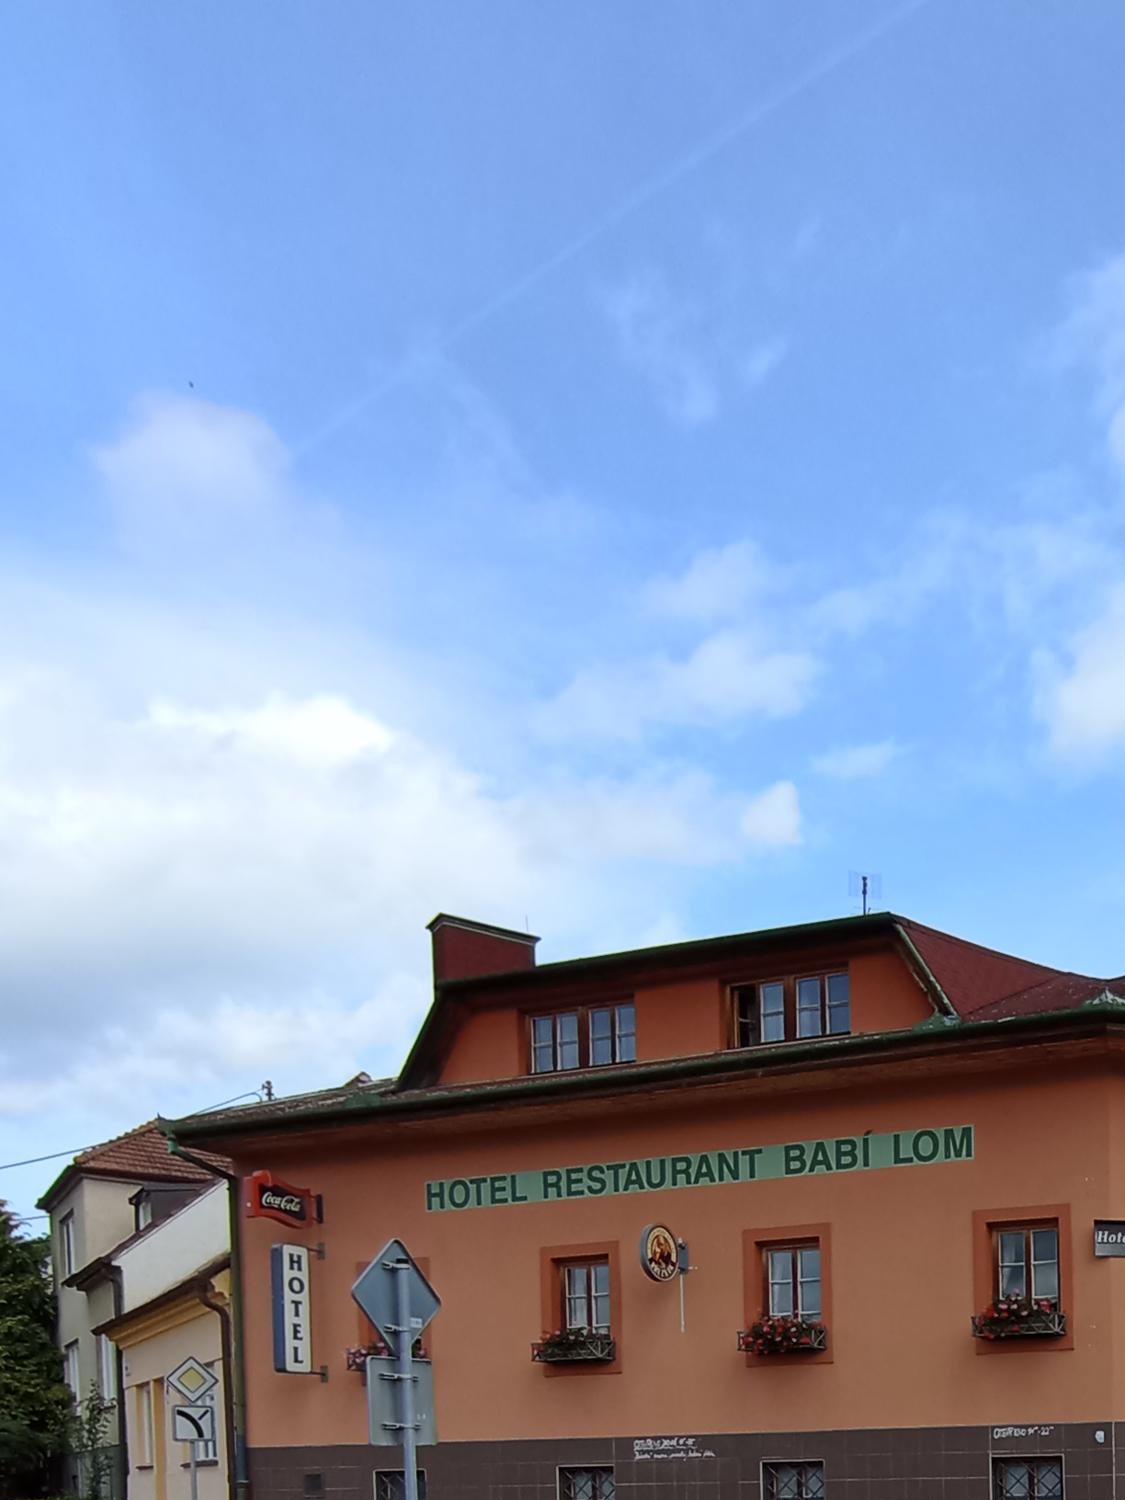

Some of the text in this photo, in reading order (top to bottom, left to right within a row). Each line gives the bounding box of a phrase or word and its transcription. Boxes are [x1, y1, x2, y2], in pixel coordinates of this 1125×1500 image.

[426, 1125, 973, 1211] HOTEL RESTAURANT BABÍ LOM
[288, 1252, 305, 1364] HOTEL
